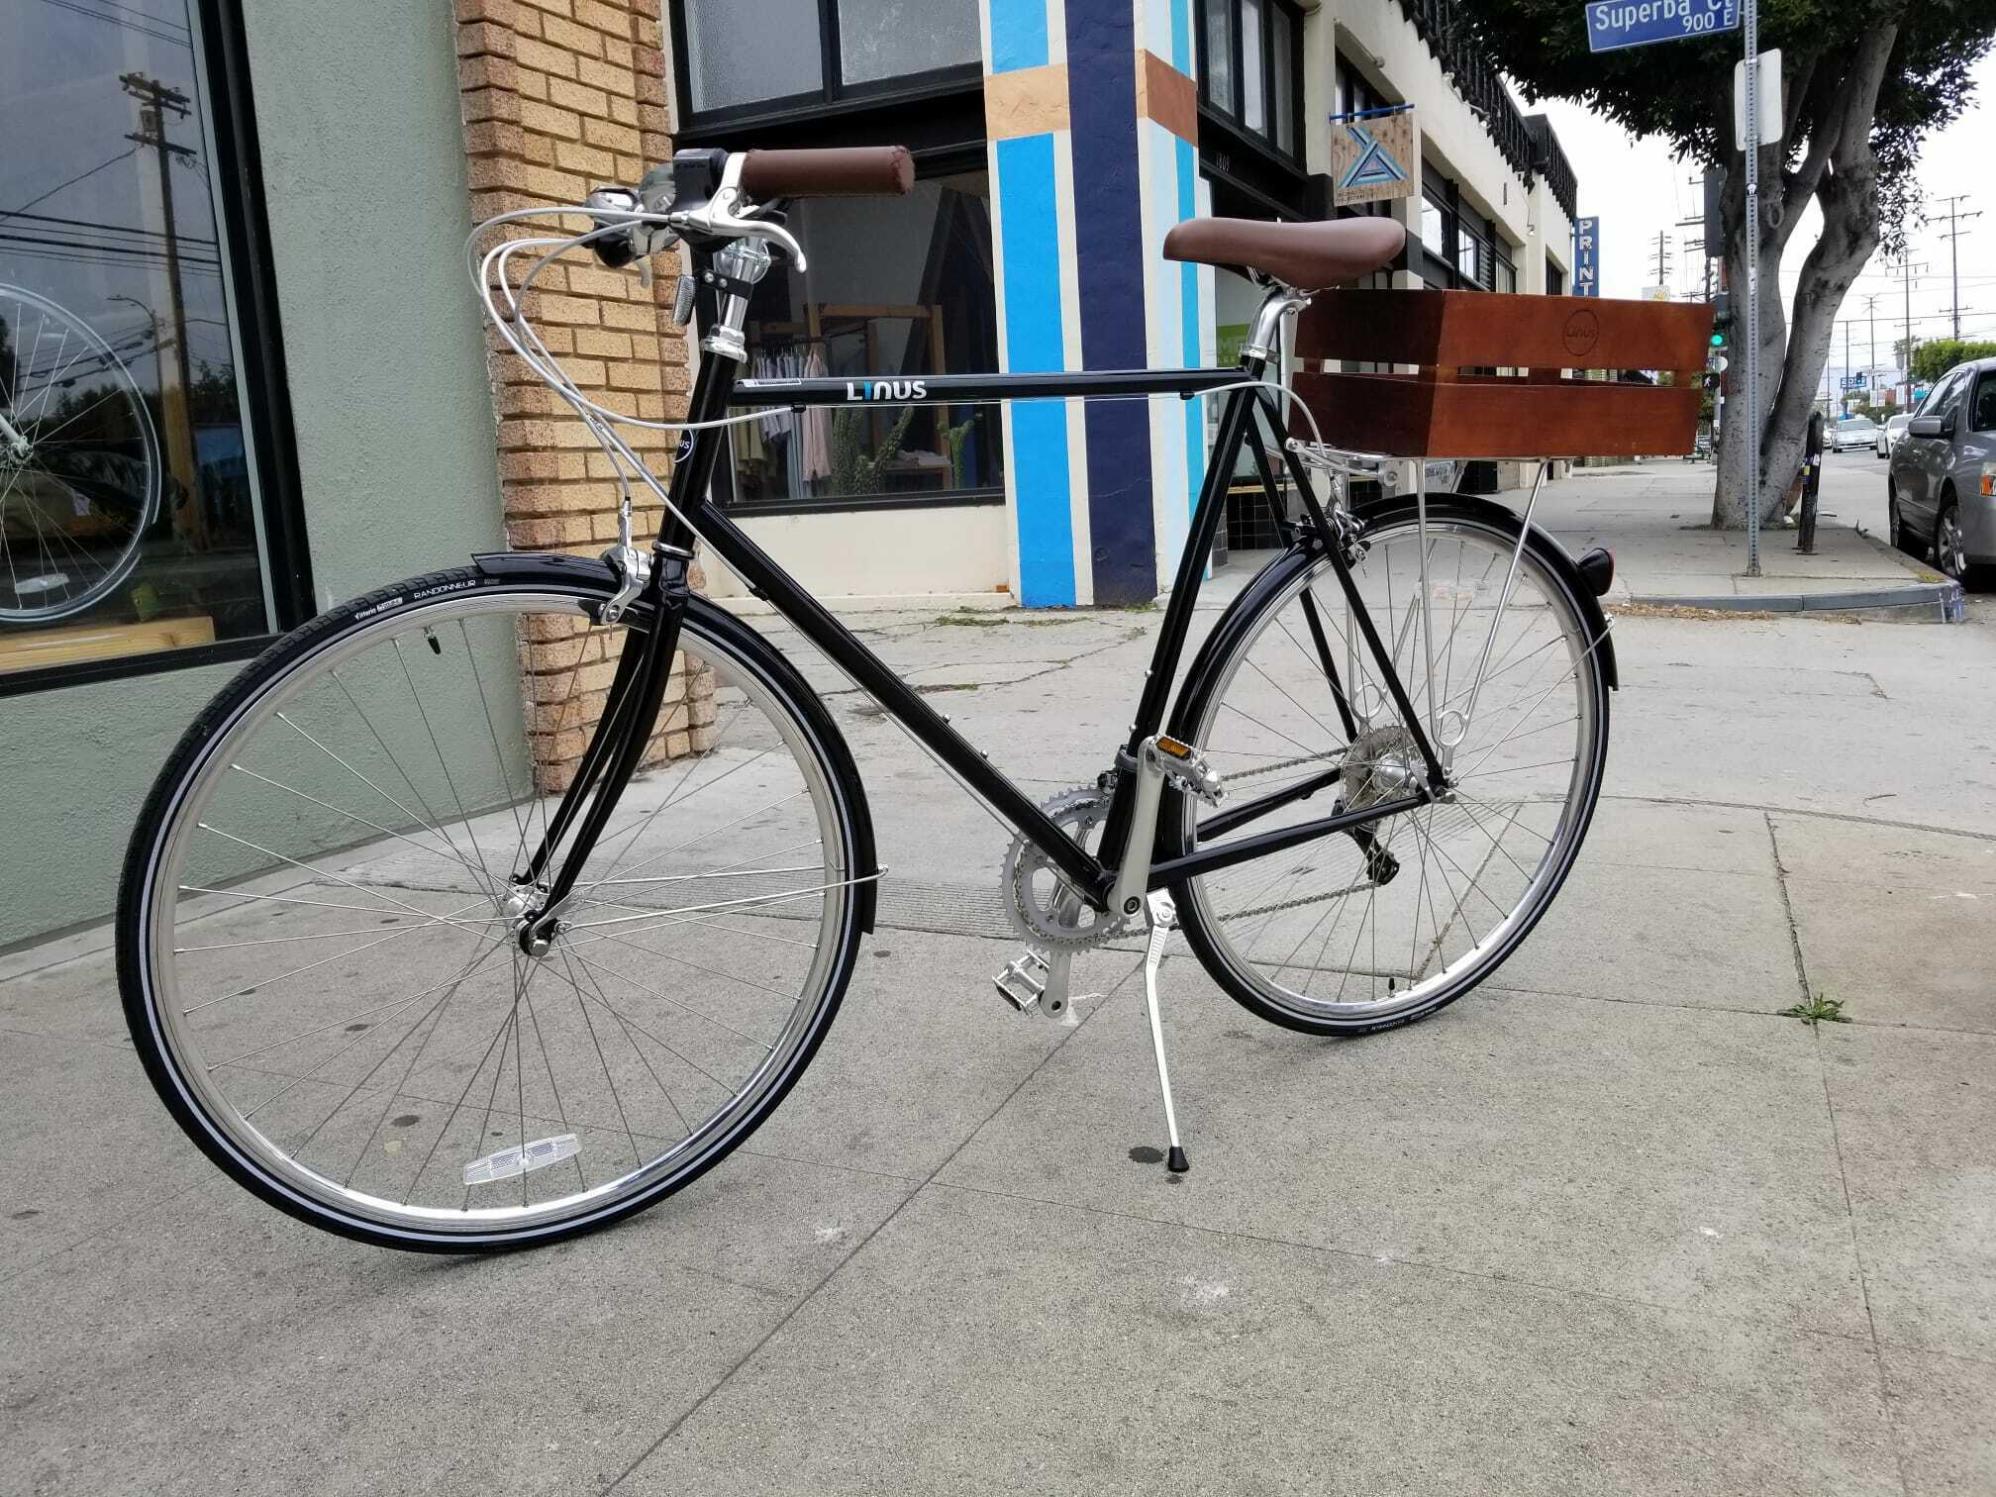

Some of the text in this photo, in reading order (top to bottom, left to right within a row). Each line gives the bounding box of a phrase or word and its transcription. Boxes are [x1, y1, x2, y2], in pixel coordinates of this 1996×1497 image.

[1595, 0, 1690, 32] Superba
[1683, 8, 1733, 32] 900 E
[1579, 220, 1594, 297] PRINT
[413, 579, 476, 600] RANDONNEUR
